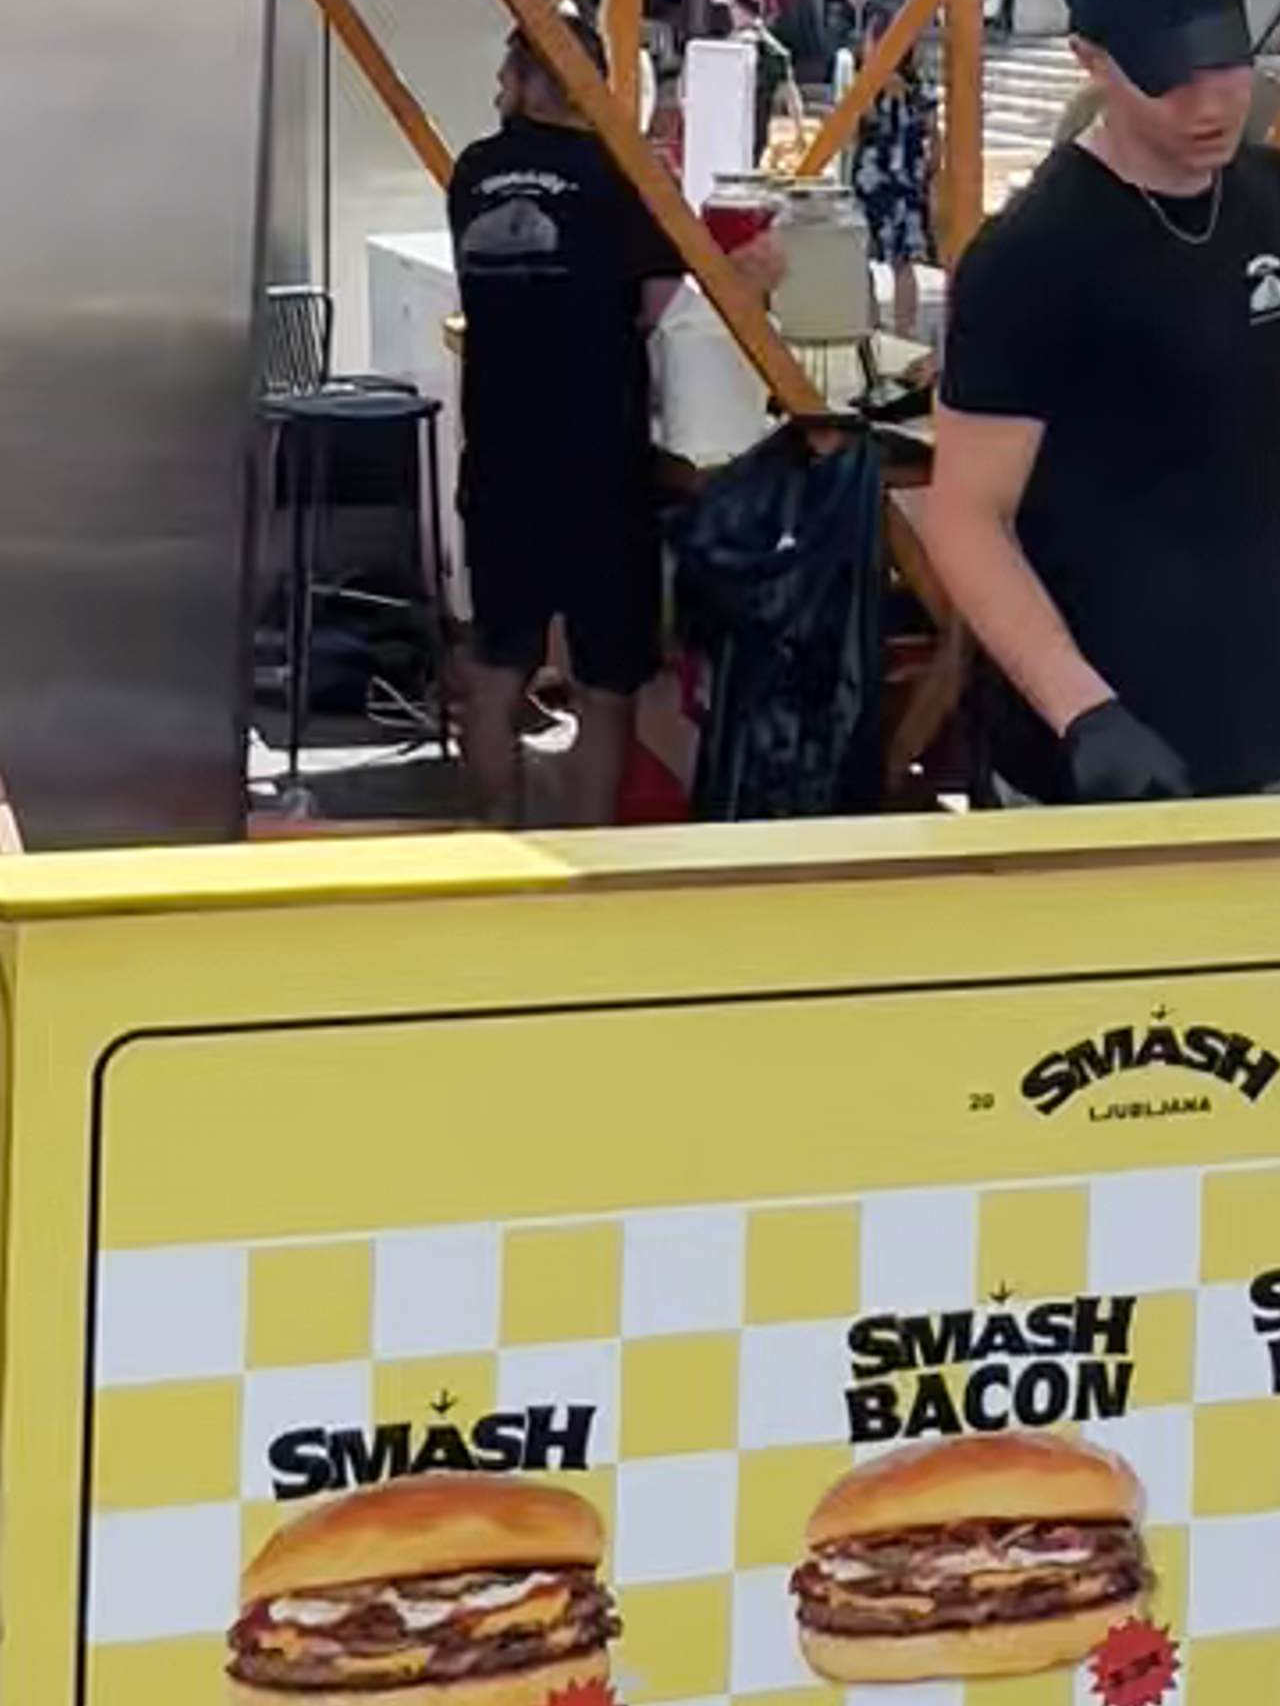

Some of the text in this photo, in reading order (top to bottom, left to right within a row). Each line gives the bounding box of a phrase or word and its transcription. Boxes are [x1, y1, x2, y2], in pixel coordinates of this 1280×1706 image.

[968, 1092, 995, 1111] 20
[1089, 1096, 1212, 1123] LJUBLJANA
[847, 1295, 1137, 1379] SMASH
[845, 1360, 1135, 1444] BACON
[267, 1404, 598, 1501] SMASH
